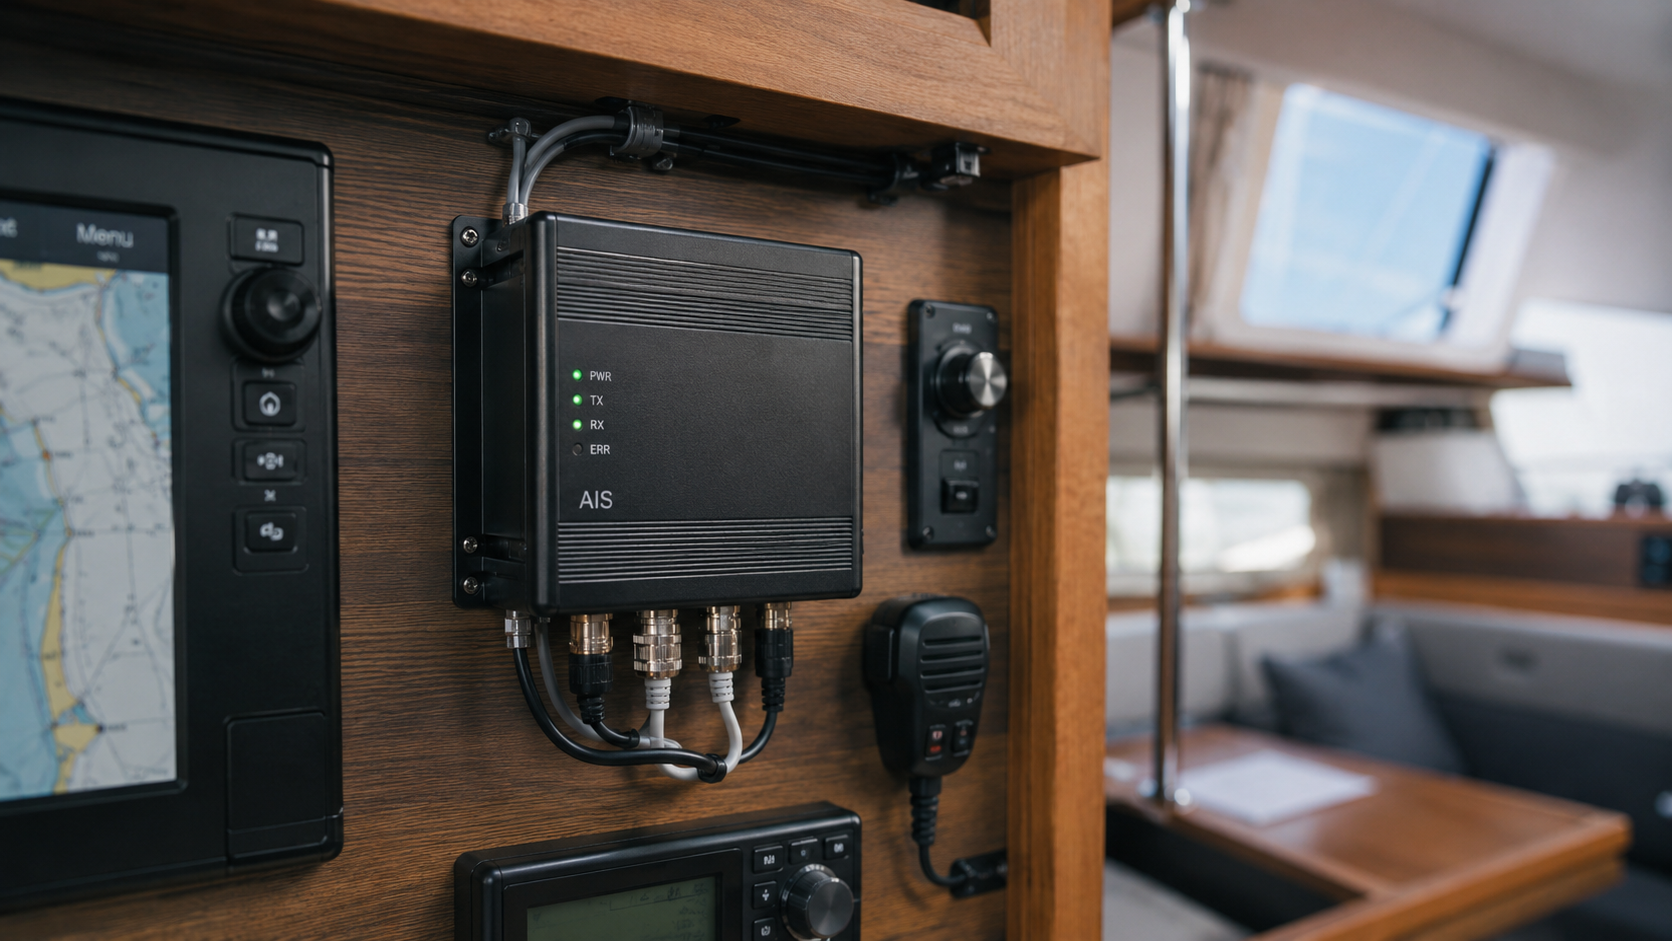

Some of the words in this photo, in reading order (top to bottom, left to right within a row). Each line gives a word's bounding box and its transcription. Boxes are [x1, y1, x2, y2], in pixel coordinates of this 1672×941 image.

[76, 222, 134, 248] Menu
[589, 370, 612, 382] PWR
[589, 394, 604, 406] TX
[590, 419, 605, 430] RX
[590, 444, 611, 455] ERR
[579, 490, 613, 509] AIS
